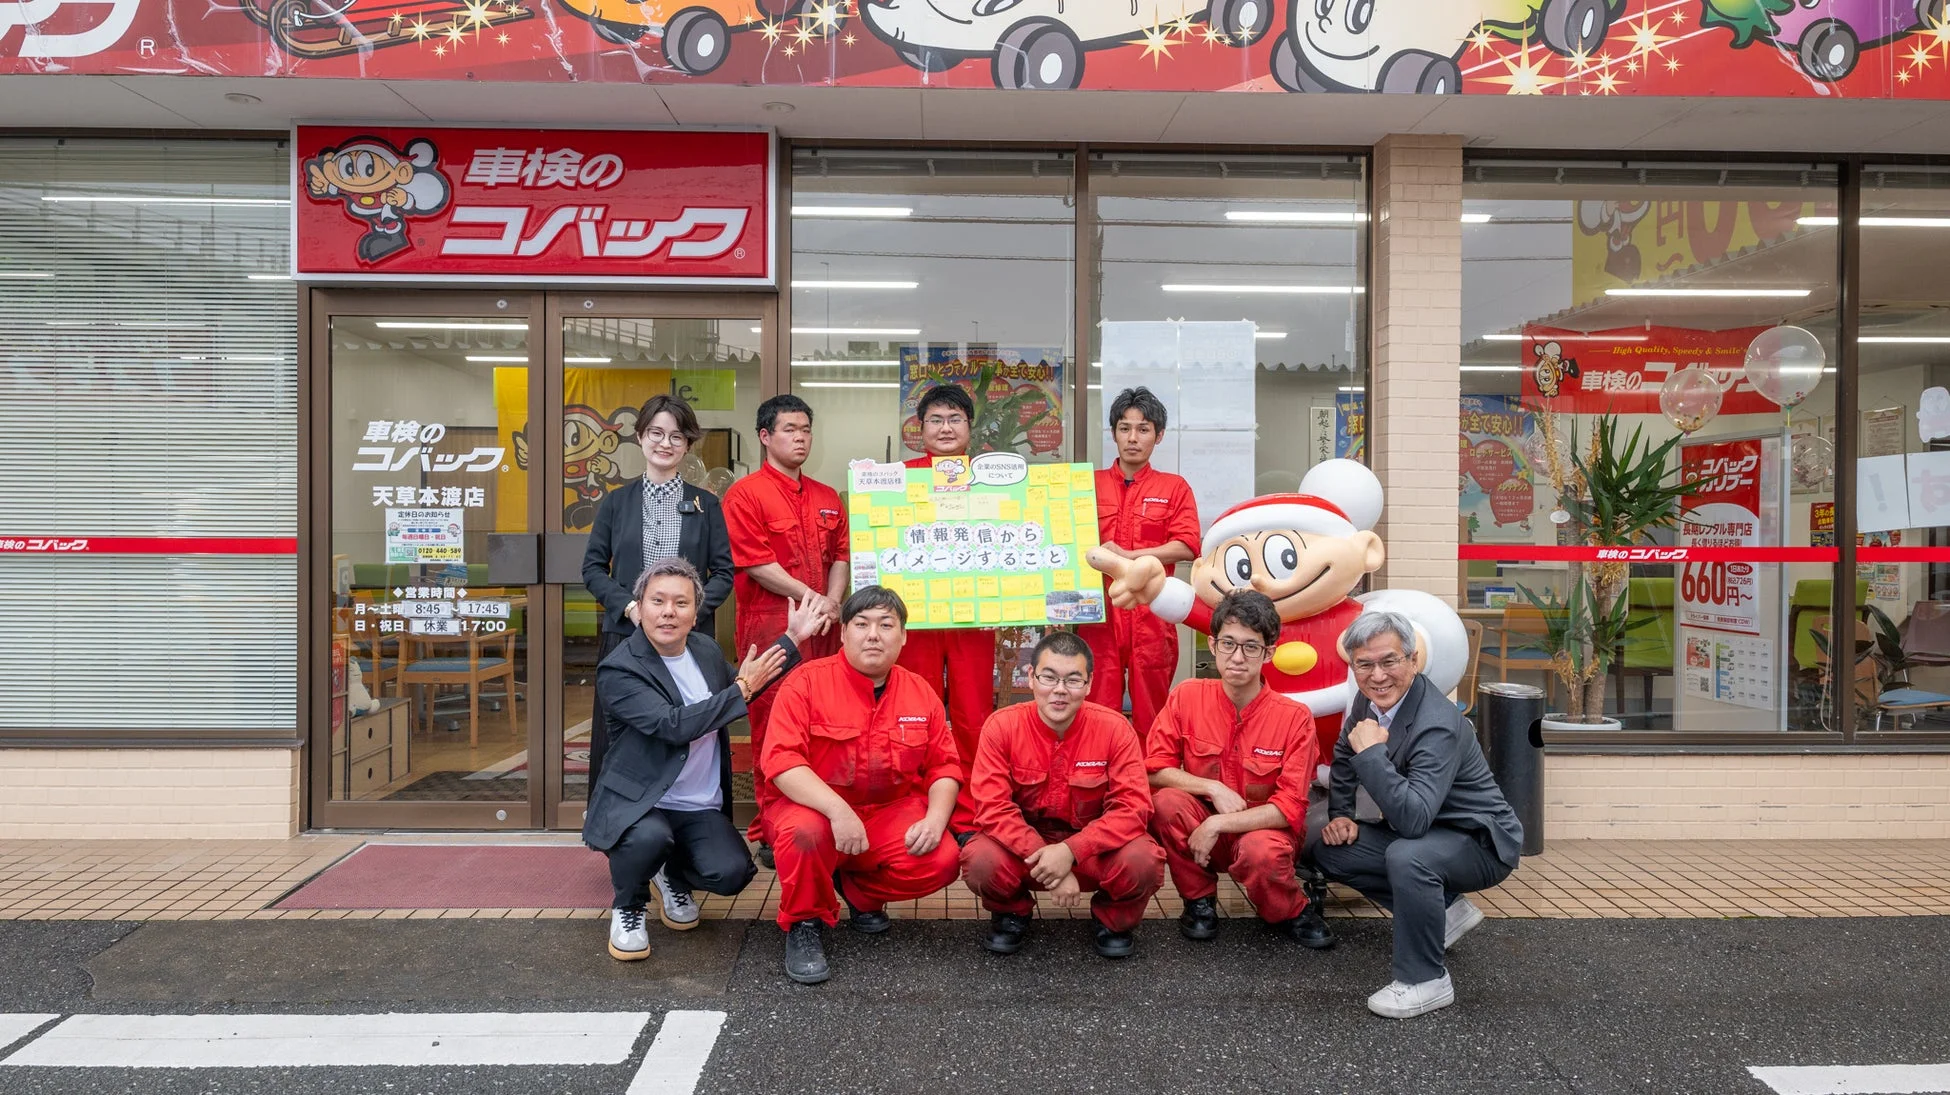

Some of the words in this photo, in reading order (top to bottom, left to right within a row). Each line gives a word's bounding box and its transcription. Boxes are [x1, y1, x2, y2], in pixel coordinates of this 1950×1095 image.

[466, 147, 624, 189] 車検の
[441, 207, 749, 259] コバック
[1613, 346, 1632, 356] High
[1634, 345, 1671, 356] Quality,
[1672, 347, 1704, 357] Speedy
[1705, 347, 1713, 356] &
[362, 420, 446, 444] 車検の
[352, 447, 505, 472] コバック
[1701, 455, 1758, 475] コバック
[988, 472, 1014, 480] について
[372, 486, 485, 508] 天草本渡店
[910, 526, 1038, 545] 情報発信から
[1682, 522, 1753, 537] 長期レンタル専門店
[886, 548, 1063, 568] イメージすること
[405, 587, 455, 599] 営業時間
[1681, 561, 1726, 606] 660
[415, 603, 441, 614] 8:45
[468, 603, 499, 614] 17:45
[423, 620, 448, 632] 休業
